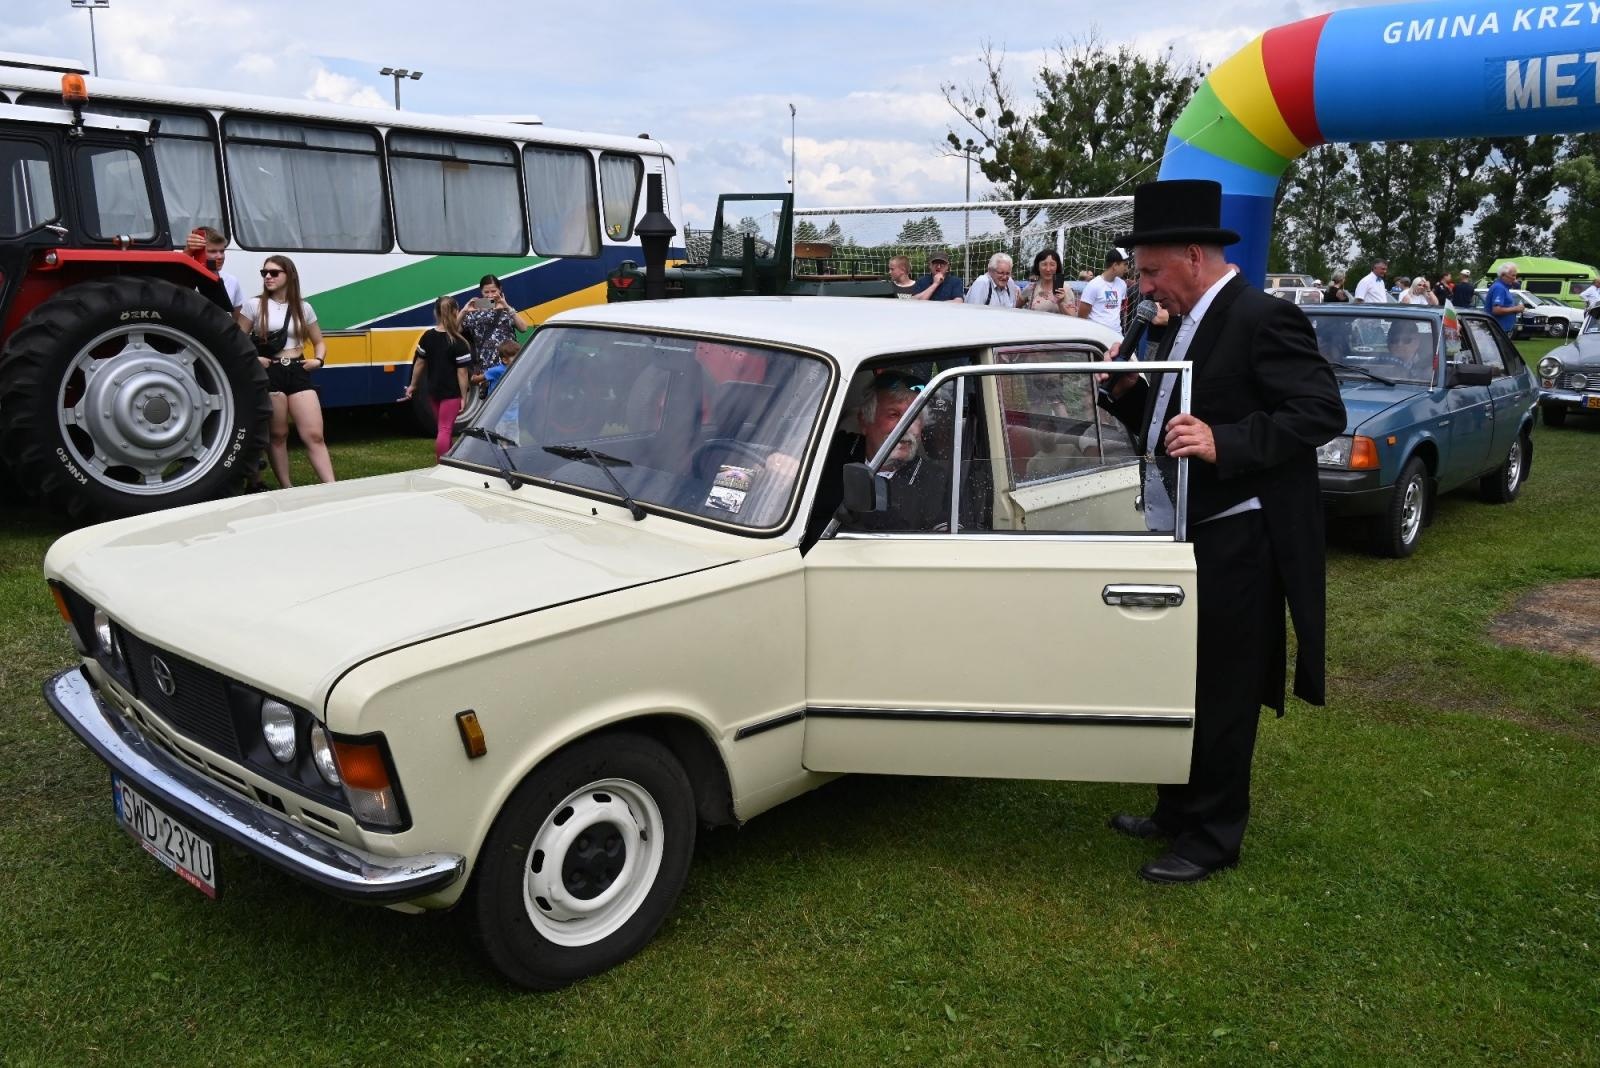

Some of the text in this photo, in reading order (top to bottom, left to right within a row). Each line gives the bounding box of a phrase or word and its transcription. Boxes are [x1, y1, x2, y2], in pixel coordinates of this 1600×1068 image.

[1383, 12, 1499, 44] GMINA
[224, 427, 246, 468] 13.6-36
[122, 786, 158, 842] SWD
[163, 817, 212, 881] 23YU
